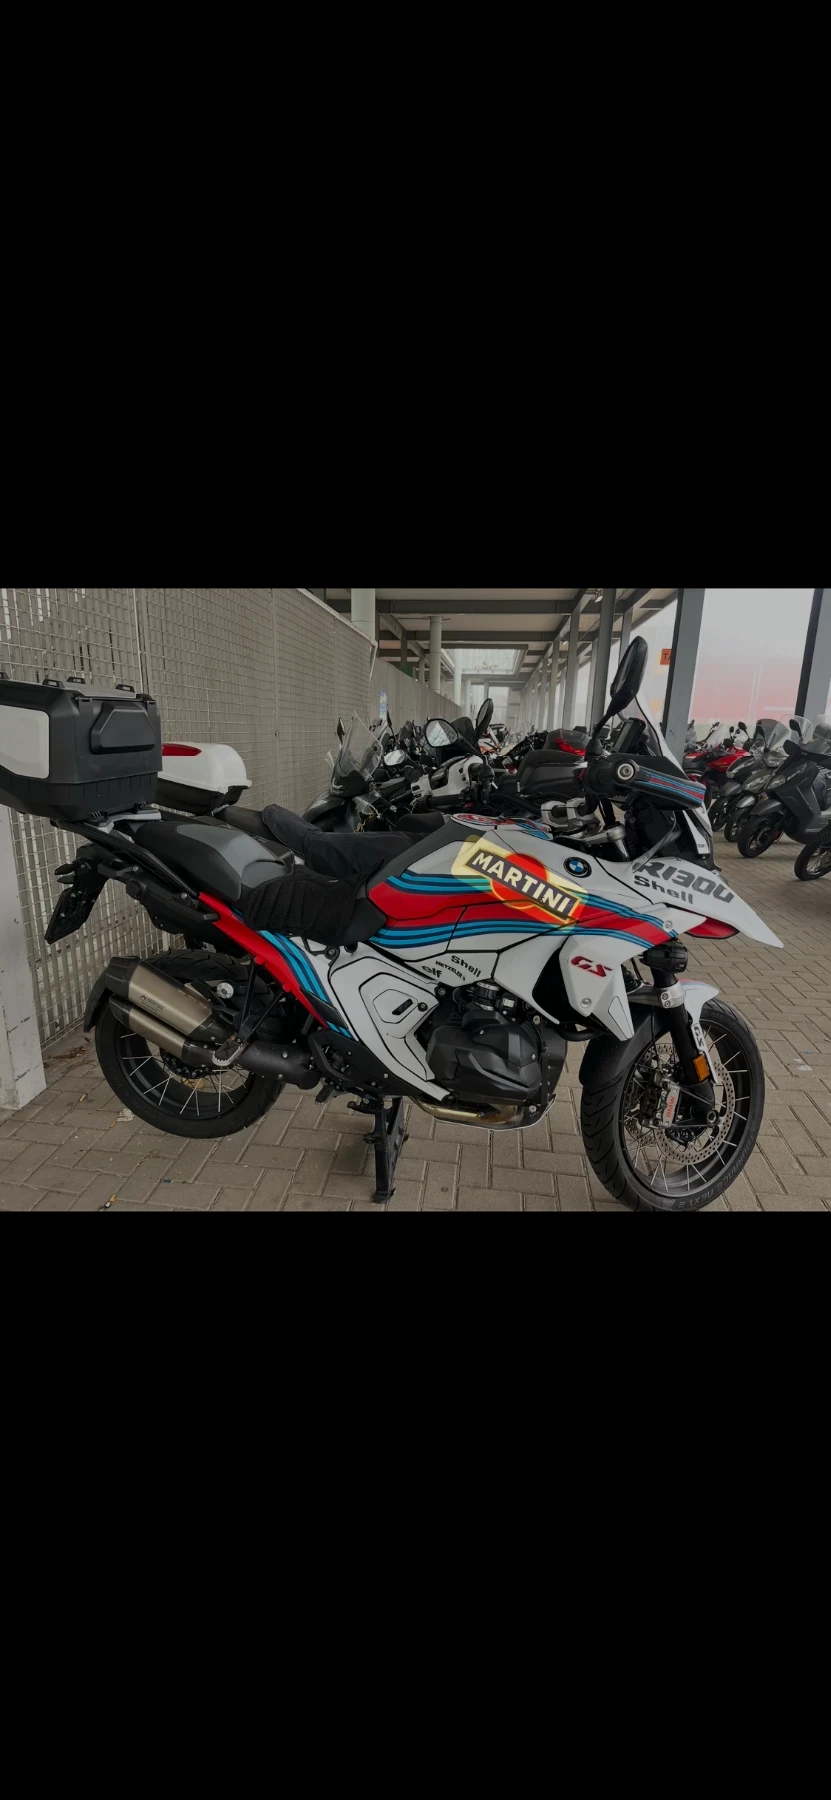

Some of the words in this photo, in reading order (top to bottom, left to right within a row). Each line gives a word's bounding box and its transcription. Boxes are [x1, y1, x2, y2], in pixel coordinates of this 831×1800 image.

[472, 852, 572, 913] MARTINI
[634, 875, 694, 905] Shell
[435, 960, 463, 979] METZELER
[451, 955, 481, 978] Shell
[571, 956, 612, 977] GS
[666, 1096, 676, 1119] BMW
